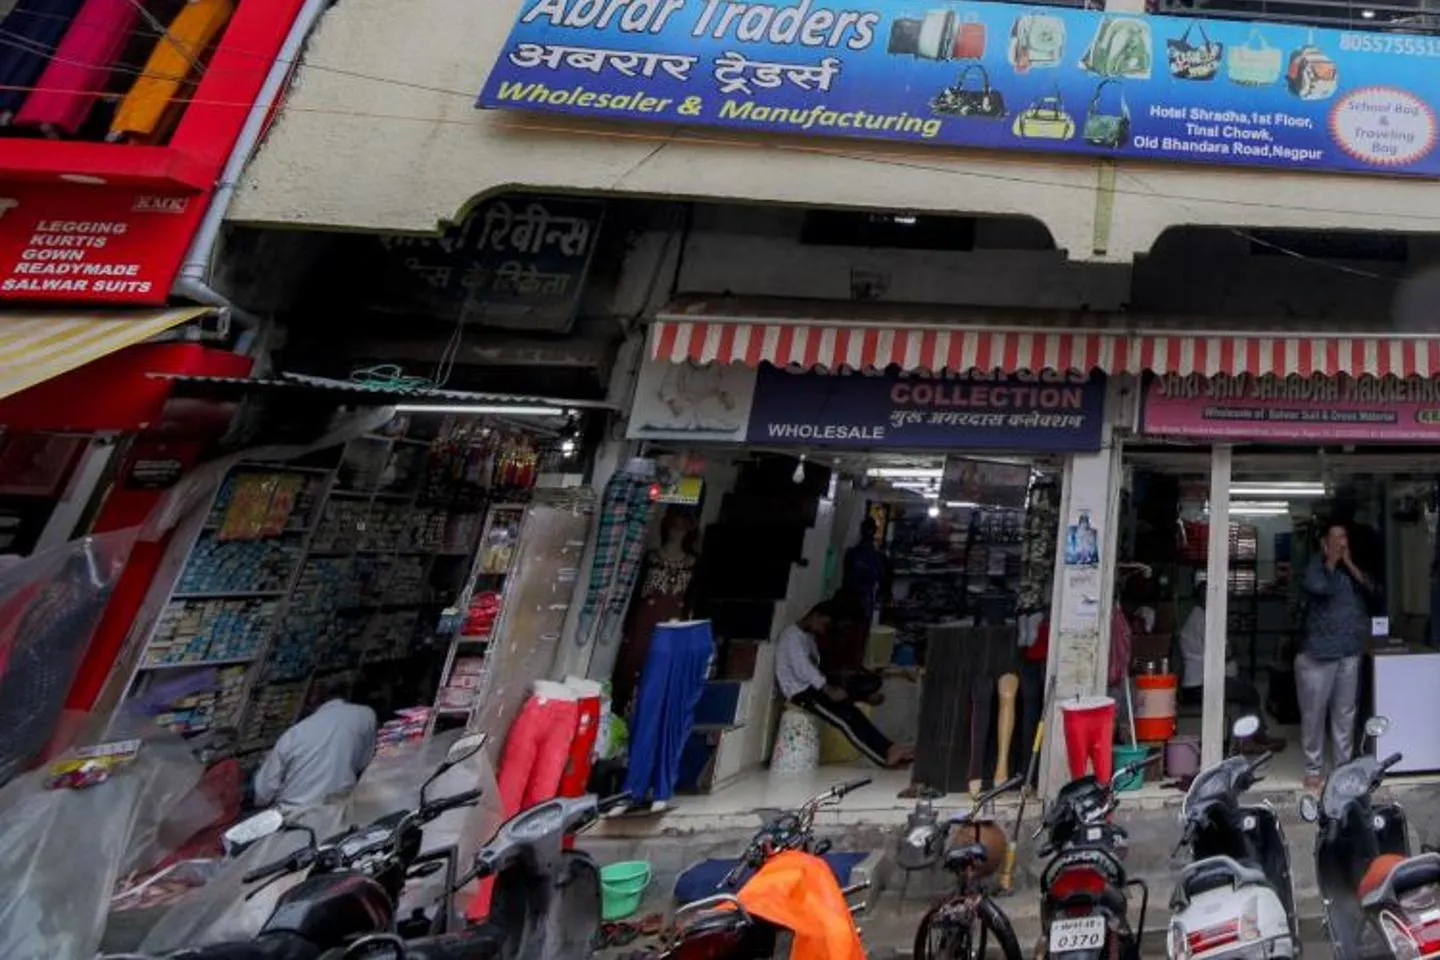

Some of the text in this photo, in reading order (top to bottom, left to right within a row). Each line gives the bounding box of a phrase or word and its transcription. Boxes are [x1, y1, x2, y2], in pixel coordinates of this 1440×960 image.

[507, 42, 842, 95] अबरार ट्रेडर्स
[496, 80, 942, 138] Wholesaler & Manufacturing
[1133, 137, 1158, 149] Old
[1162, 138, 1230, 155] Bhandara
[36, 220, 128, 234] LEGGING
[29, 234, 107, 248] KURTIS
[21, 248, 84, 261] GOWN
[13, 262, 139, 276] READYMADE
[1, 277, 153, 293] SALWAR SUITS
[890, 382, 1084, 409] COLLECTION
[767, 422, 885, 440] WHOLESALE
